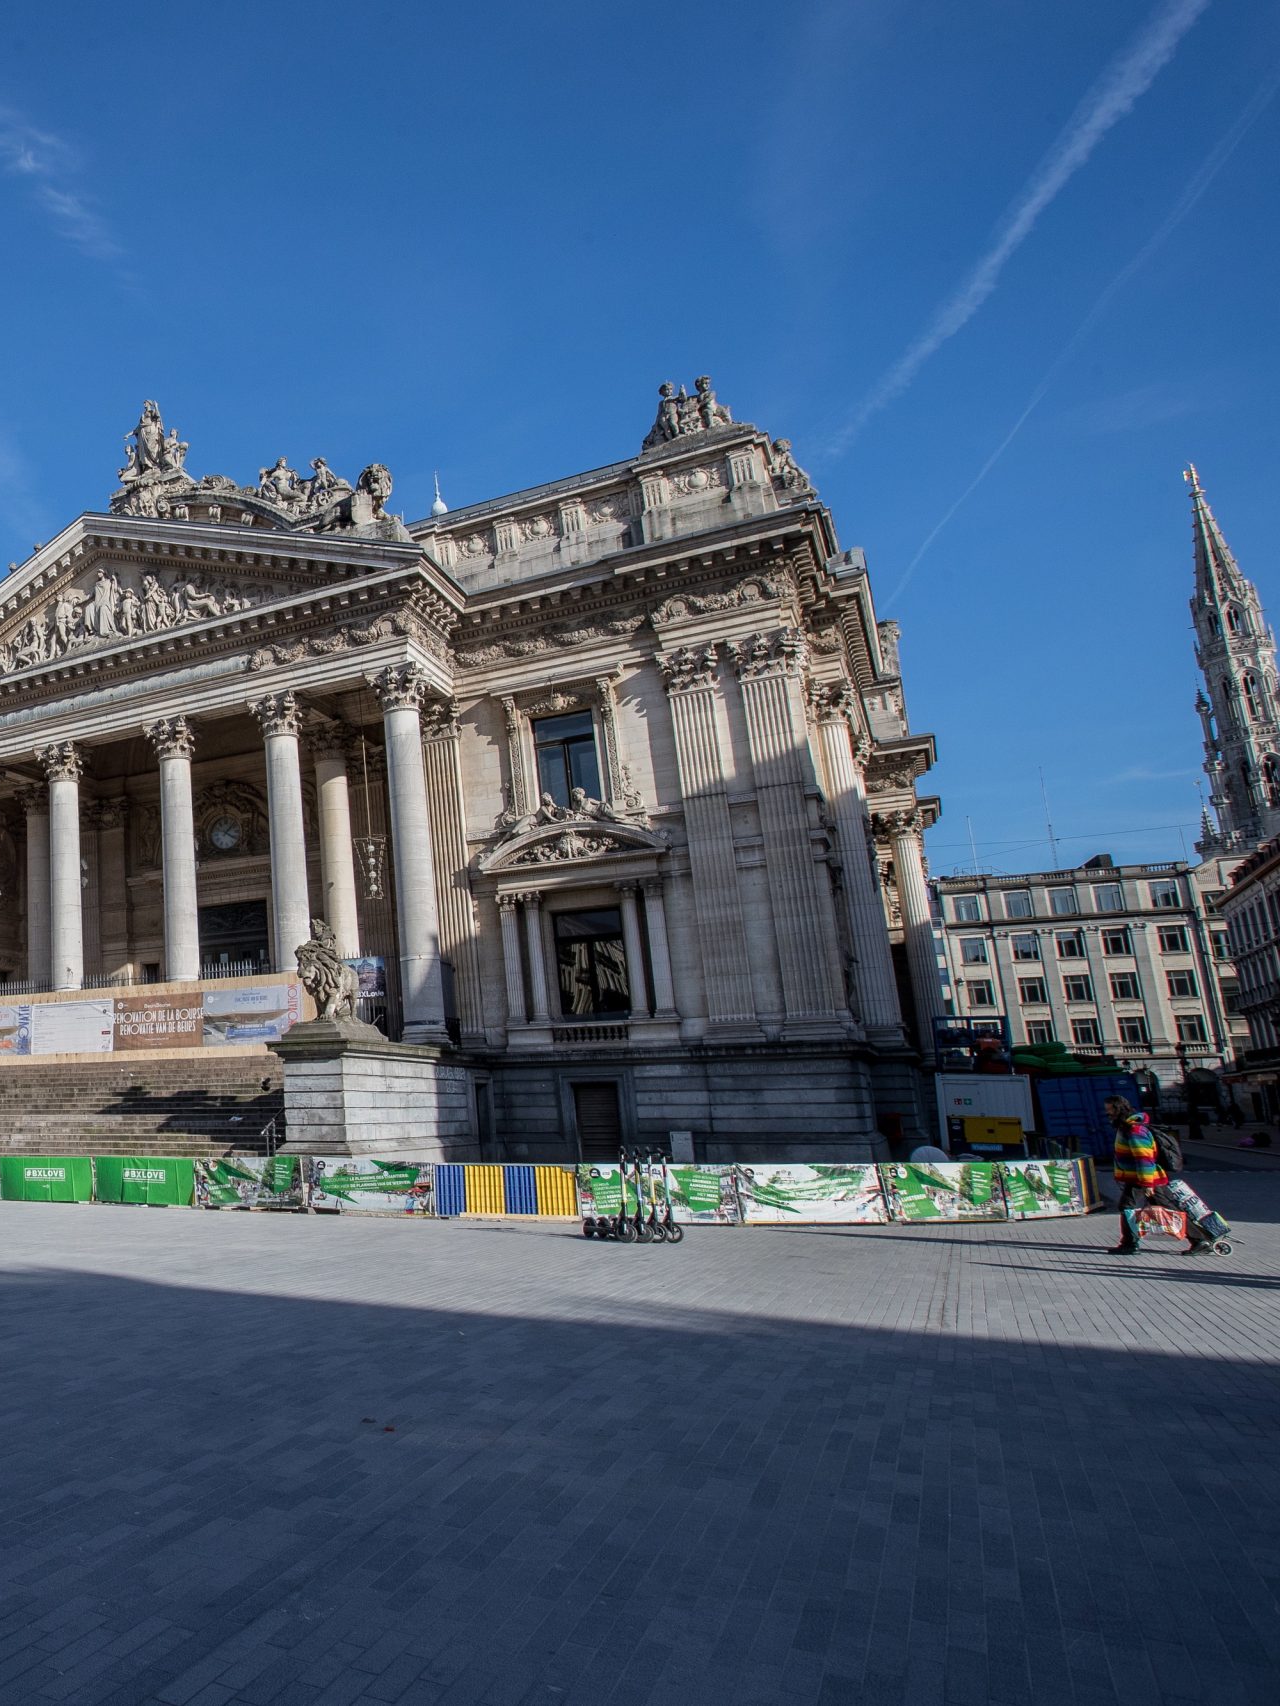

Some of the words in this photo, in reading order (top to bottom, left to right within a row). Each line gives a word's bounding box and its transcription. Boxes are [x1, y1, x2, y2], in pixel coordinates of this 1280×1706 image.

[113, 1011, 157, 1024] RENOVATION
[158, 1010, 165, 1021] DE
[167, 1009, 175, 1020] LA
[175, 1007, 203, 1020] BOURSE
[120, 1023, 154, 1036] RENOVATIE
[156, 1022, 167, 1034] VAN
[169, 1022, 176, 1033] DE
[177, 1020, 196, 1033] BEURS
[26, 1169, 64, 1178] #BXLOVE
[124, 1170, 164, 1179] #BXLOVE
